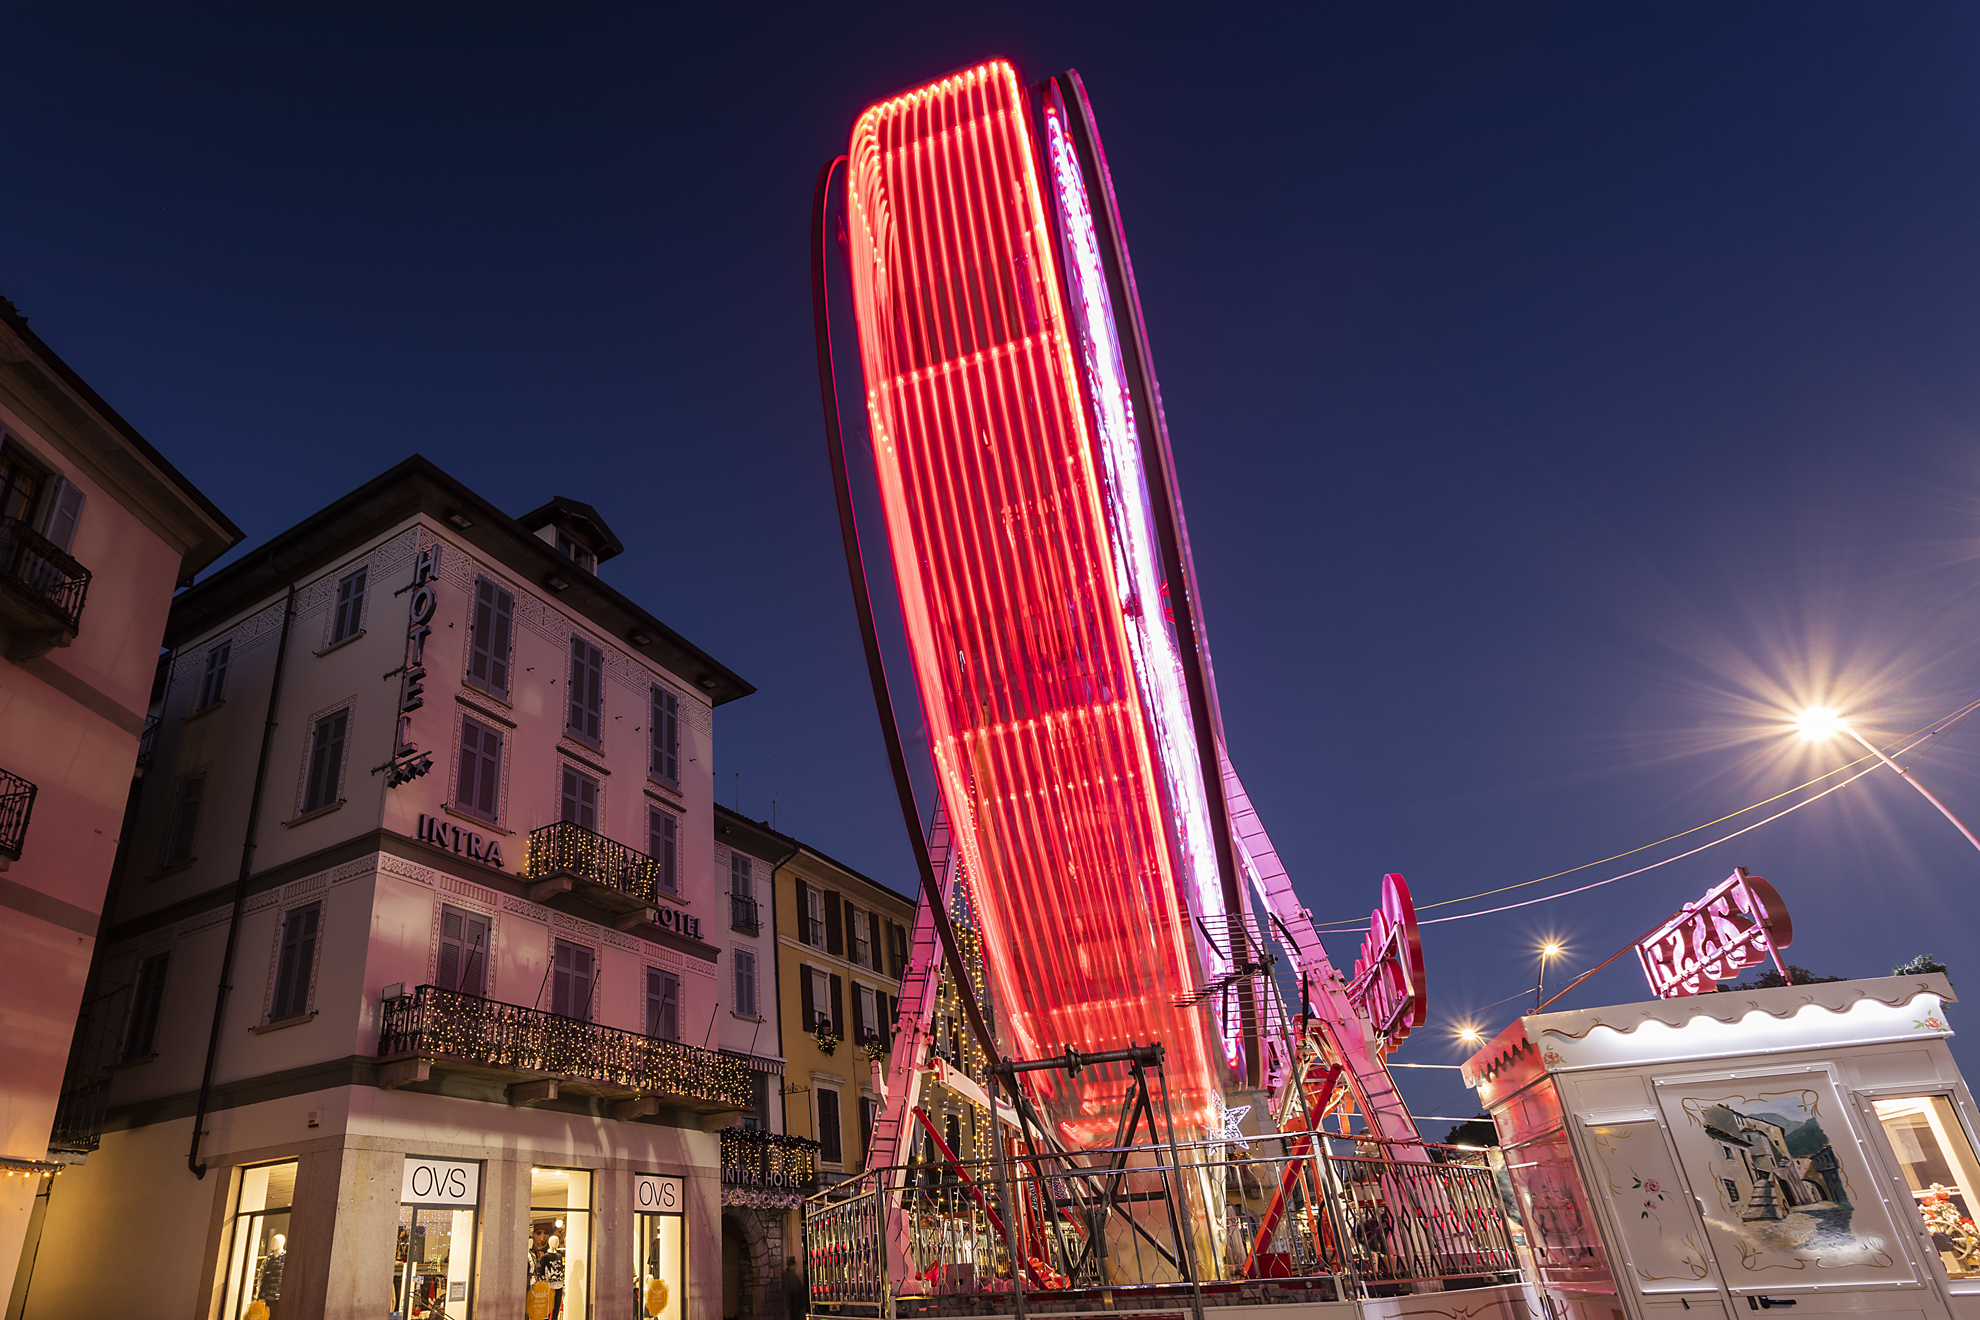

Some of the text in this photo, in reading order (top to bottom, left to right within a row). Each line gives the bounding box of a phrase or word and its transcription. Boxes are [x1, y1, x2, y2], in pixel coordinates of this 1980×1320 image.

[397, 544, 442, 758] HOTEL
[419, 813, 505, 867] INTRA
[411, 1165, 467, 1198] OVS
[638, 1181, 675, 1207] OVS
[721, 1167, 801, 1188] INTRA HOTEL
